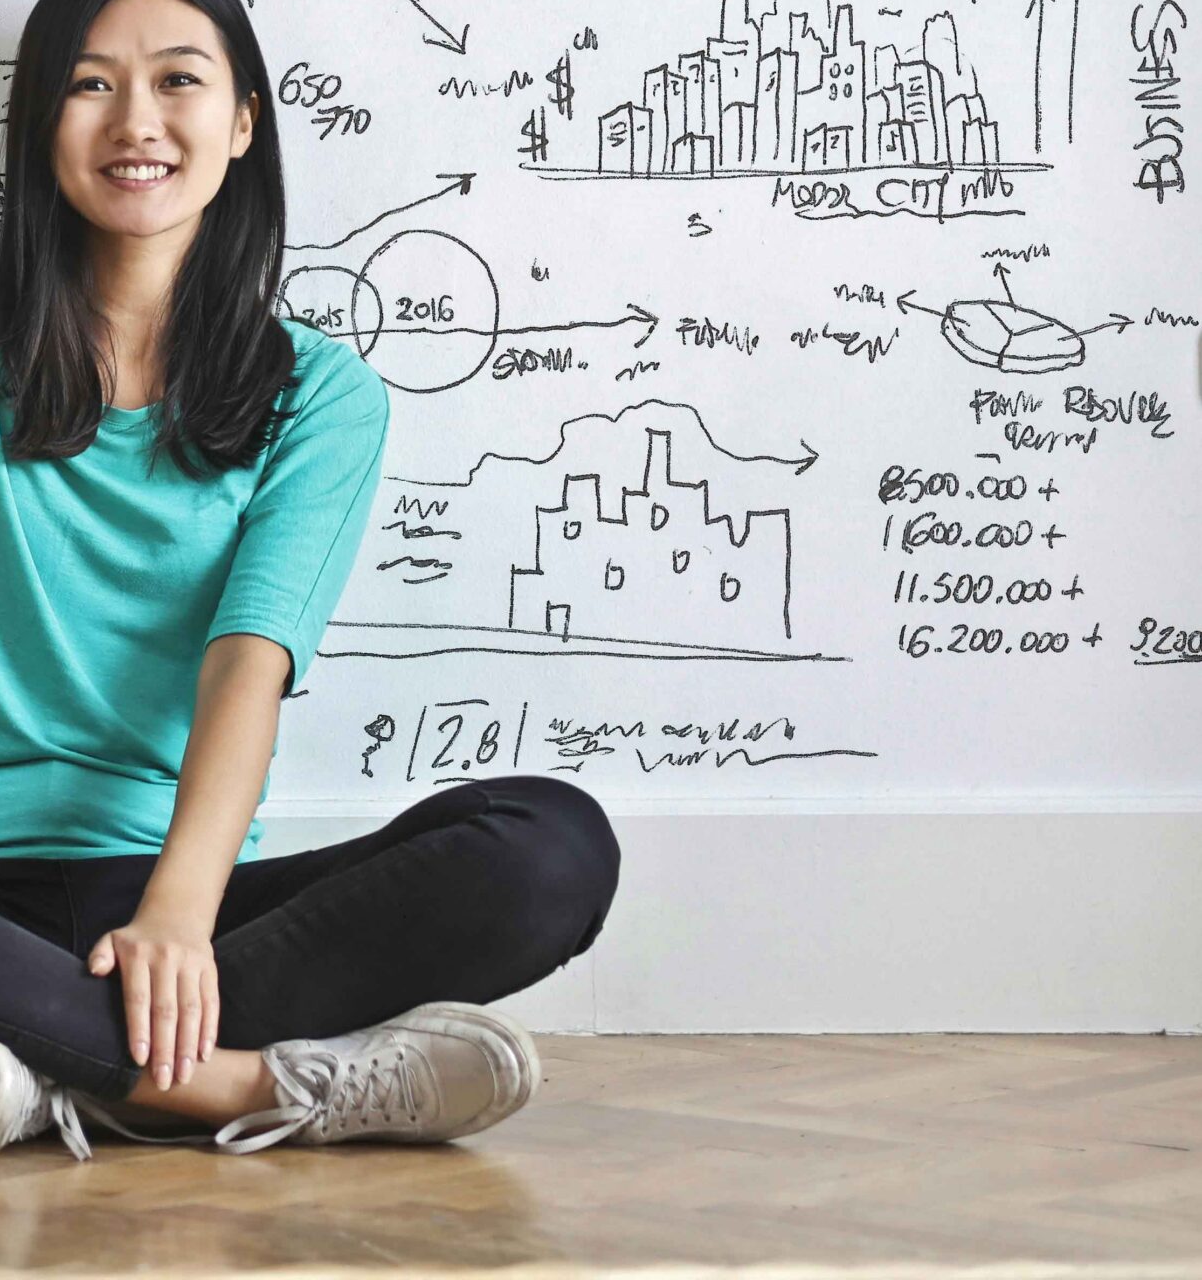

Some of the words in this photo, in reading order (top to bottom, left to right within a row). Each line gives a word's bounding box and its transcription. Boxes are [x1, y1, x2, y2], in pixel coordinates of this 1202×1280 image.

[279, 62, 342, 107] 650
[1129, 0, 1187, 204] BUSINESS
[395, 295, 455, 323] 2016
[894, 570, 1052, 605] 11.500.000
[899, 624, 1069, 658] 16.200.000
